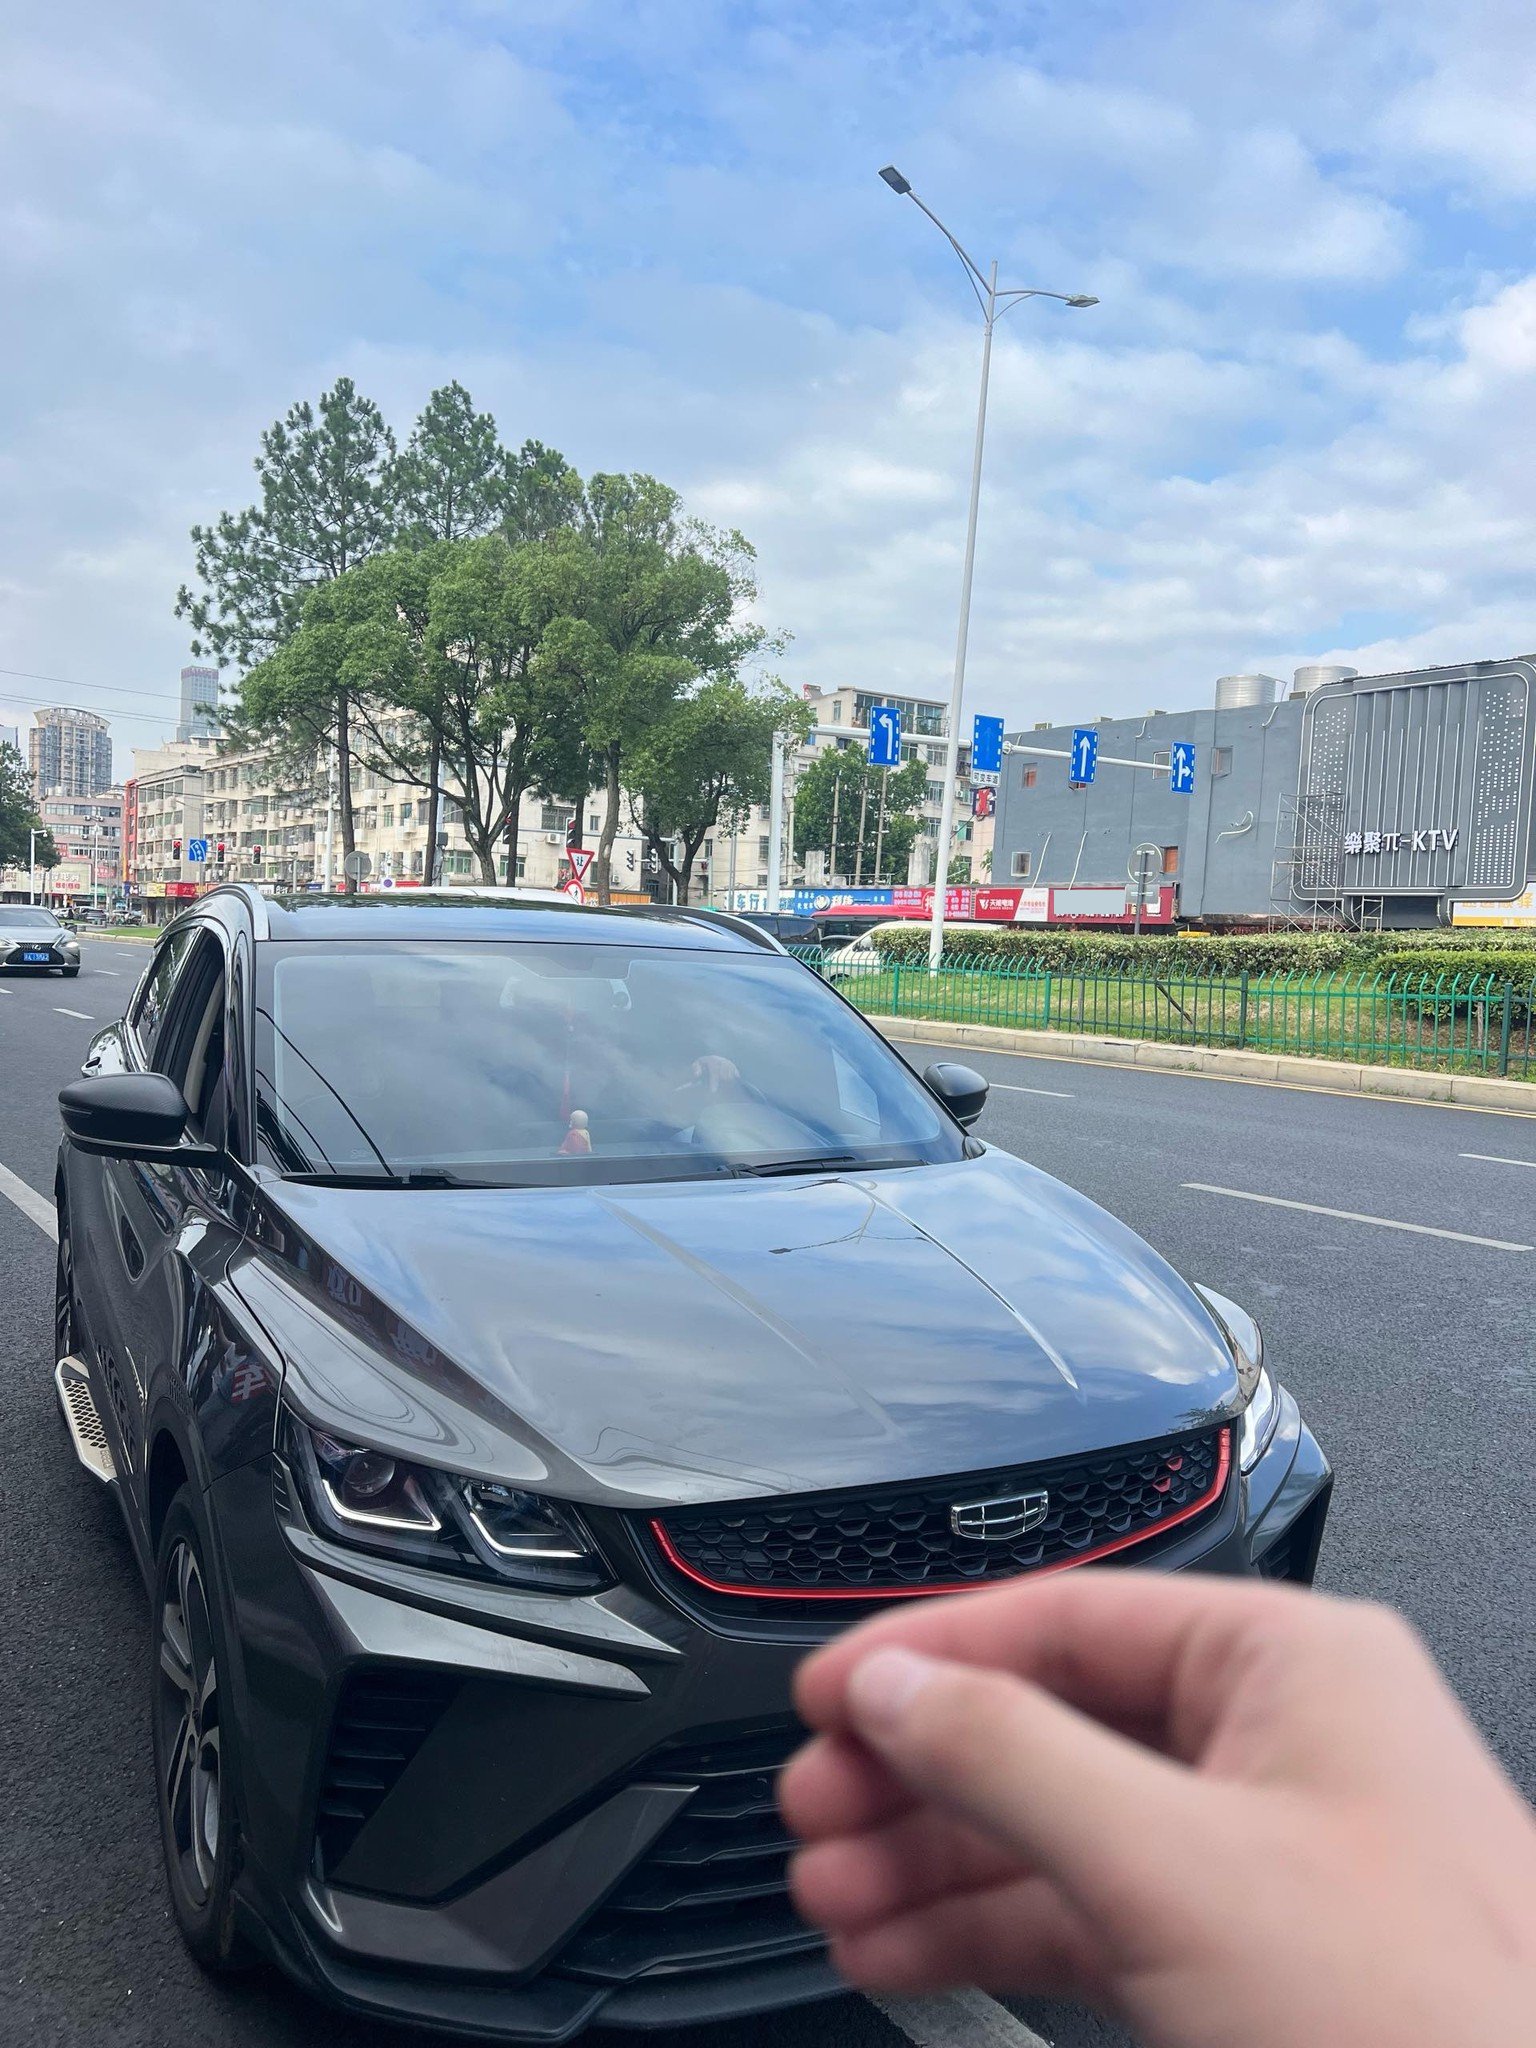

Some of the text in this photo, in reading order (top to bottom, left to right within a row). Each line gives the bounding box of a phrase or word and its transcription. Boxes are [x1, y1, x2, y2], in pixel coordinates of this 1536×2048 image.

[973, 772, 999, 785] 可变车道
[576, 856, 583, 866] 让
